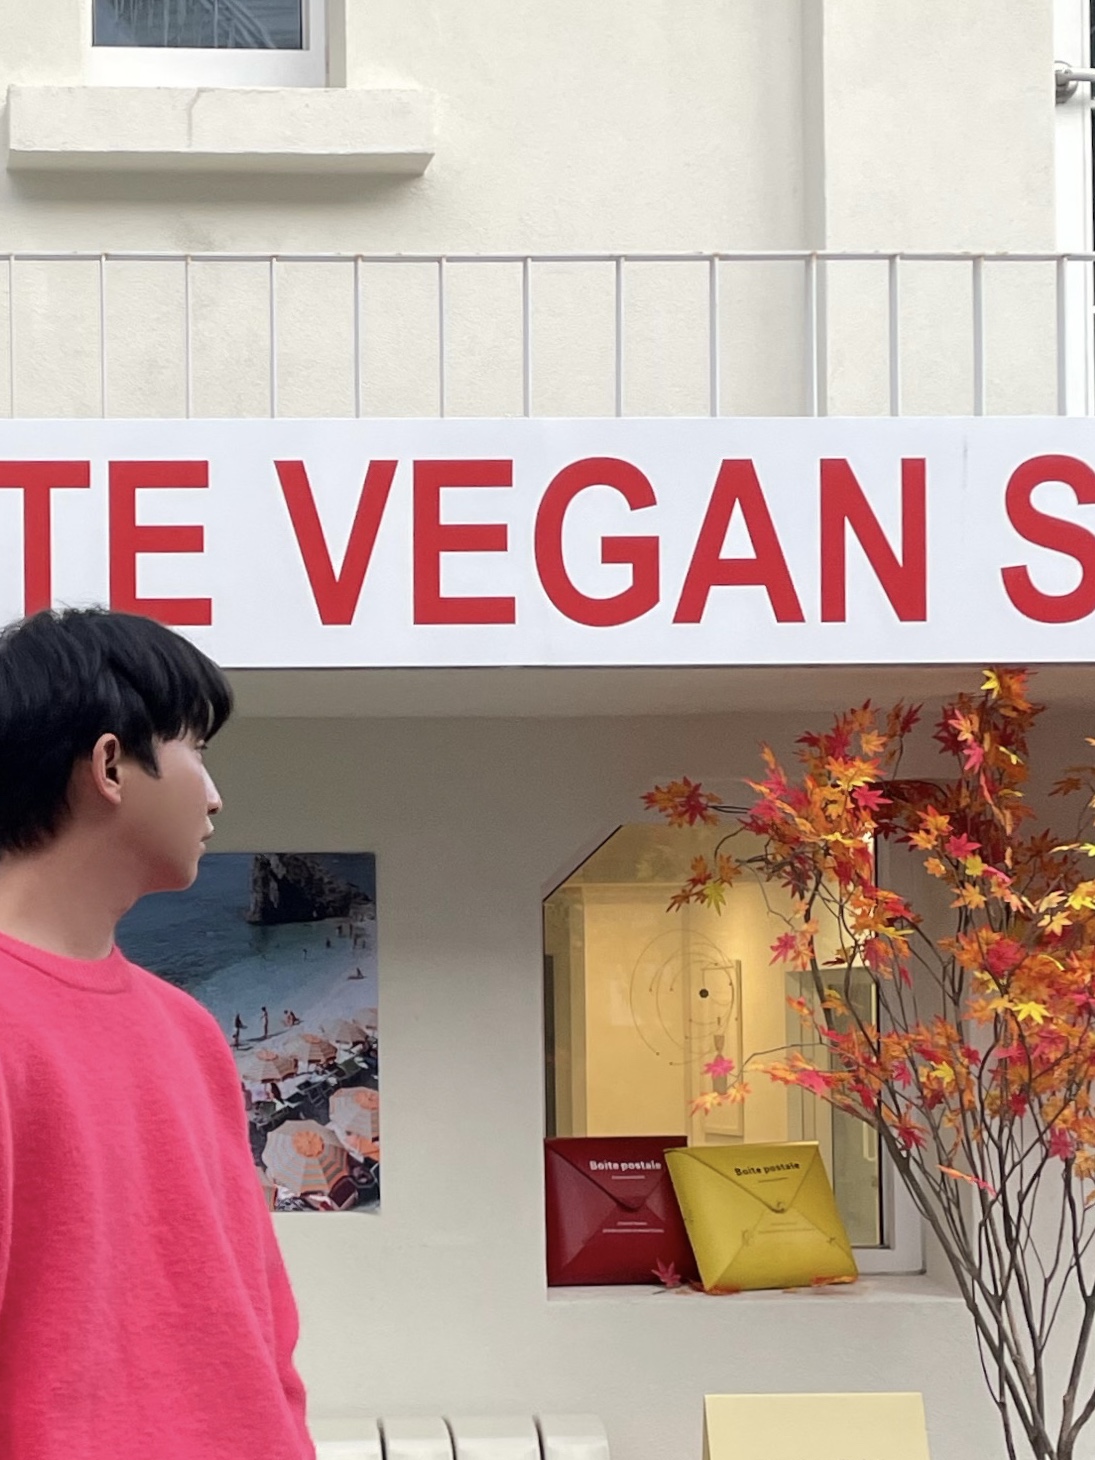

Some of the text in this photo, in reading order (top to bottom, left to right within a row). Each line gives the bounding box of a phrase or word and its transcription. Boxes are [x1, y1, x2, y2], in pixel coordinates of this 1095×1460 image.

[275, 457, 927, 626] VEGAN
[620, 1159, 662, 1172] postale
[763, 1162, 800, 1174] postale
